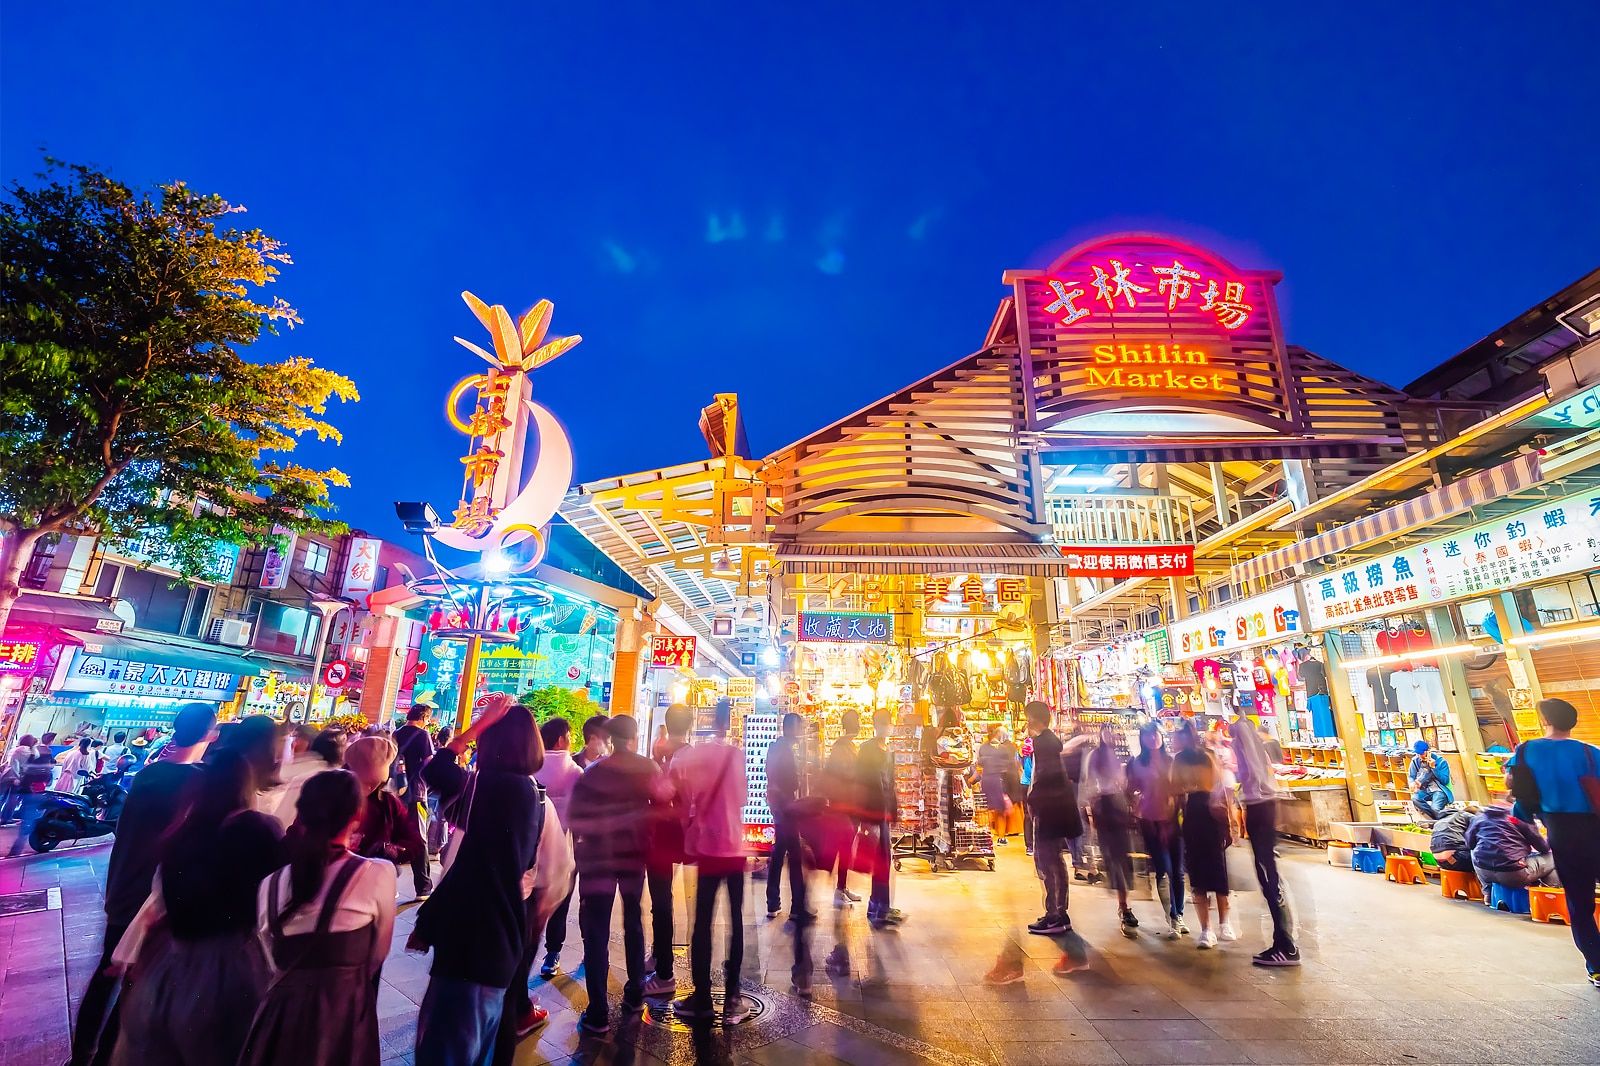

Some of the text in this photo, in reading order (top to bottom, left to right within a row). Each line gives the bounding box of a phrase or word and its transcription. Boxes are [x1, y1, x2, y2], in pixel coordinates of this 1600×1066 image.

[1044, 259, 1253, 329] 士林市場
[1094, 345, 1208, 364] Shilin
[1085, 367, 1224, 390] Market
[1443, 508, 1567, 558] 迷你釣蝦
[1067, 553, 1188, 570] 歡迎使用微信支付
[1319, 556, 1414, 601] 高級撈魚
[1324, 584, 1419, 619] 高級孔雀魚批發零售
[804, 616, 887, 639] 收藏天地
[479, 659, 544, 669] 北市公有士林市
